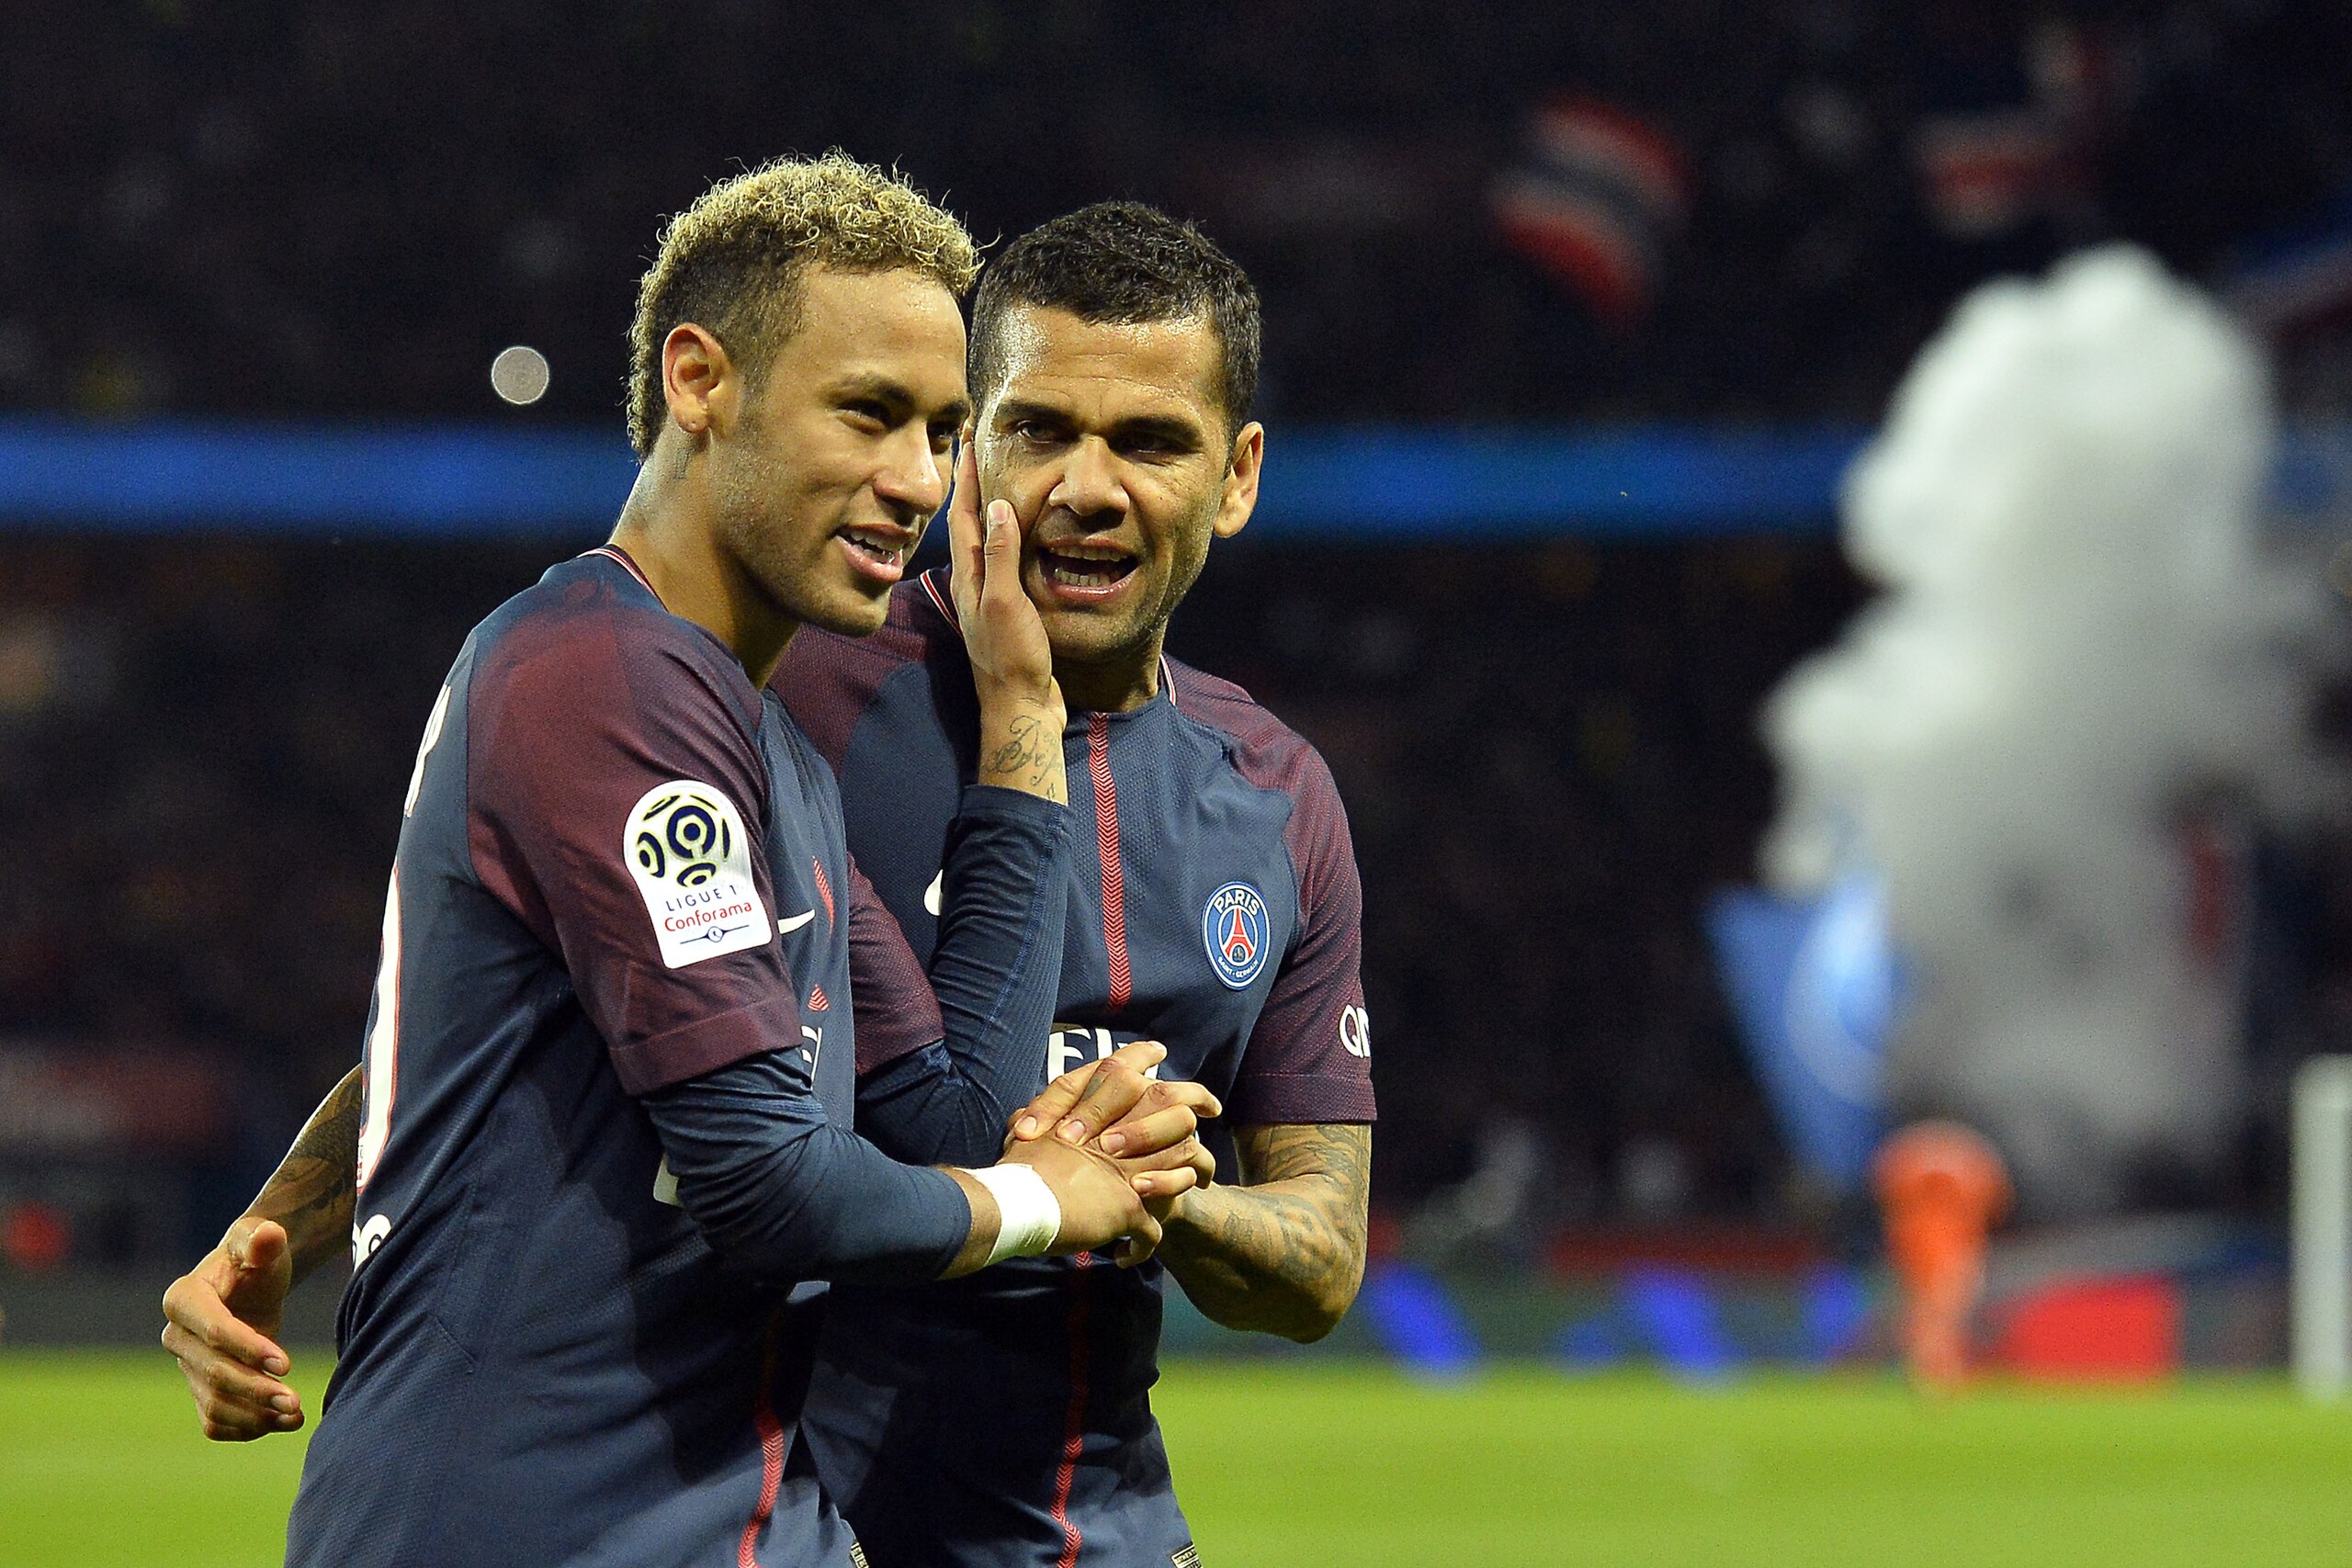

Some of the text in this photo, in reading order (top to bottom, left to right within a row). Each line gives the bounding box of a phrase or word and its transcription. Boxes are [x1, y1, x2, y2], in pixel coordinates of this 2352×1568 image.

[665, 885, 738, 912] LIGUE 1
[1214, 889, 1261, 917] PARIS
[664, 901, 753, 932] Conforama
